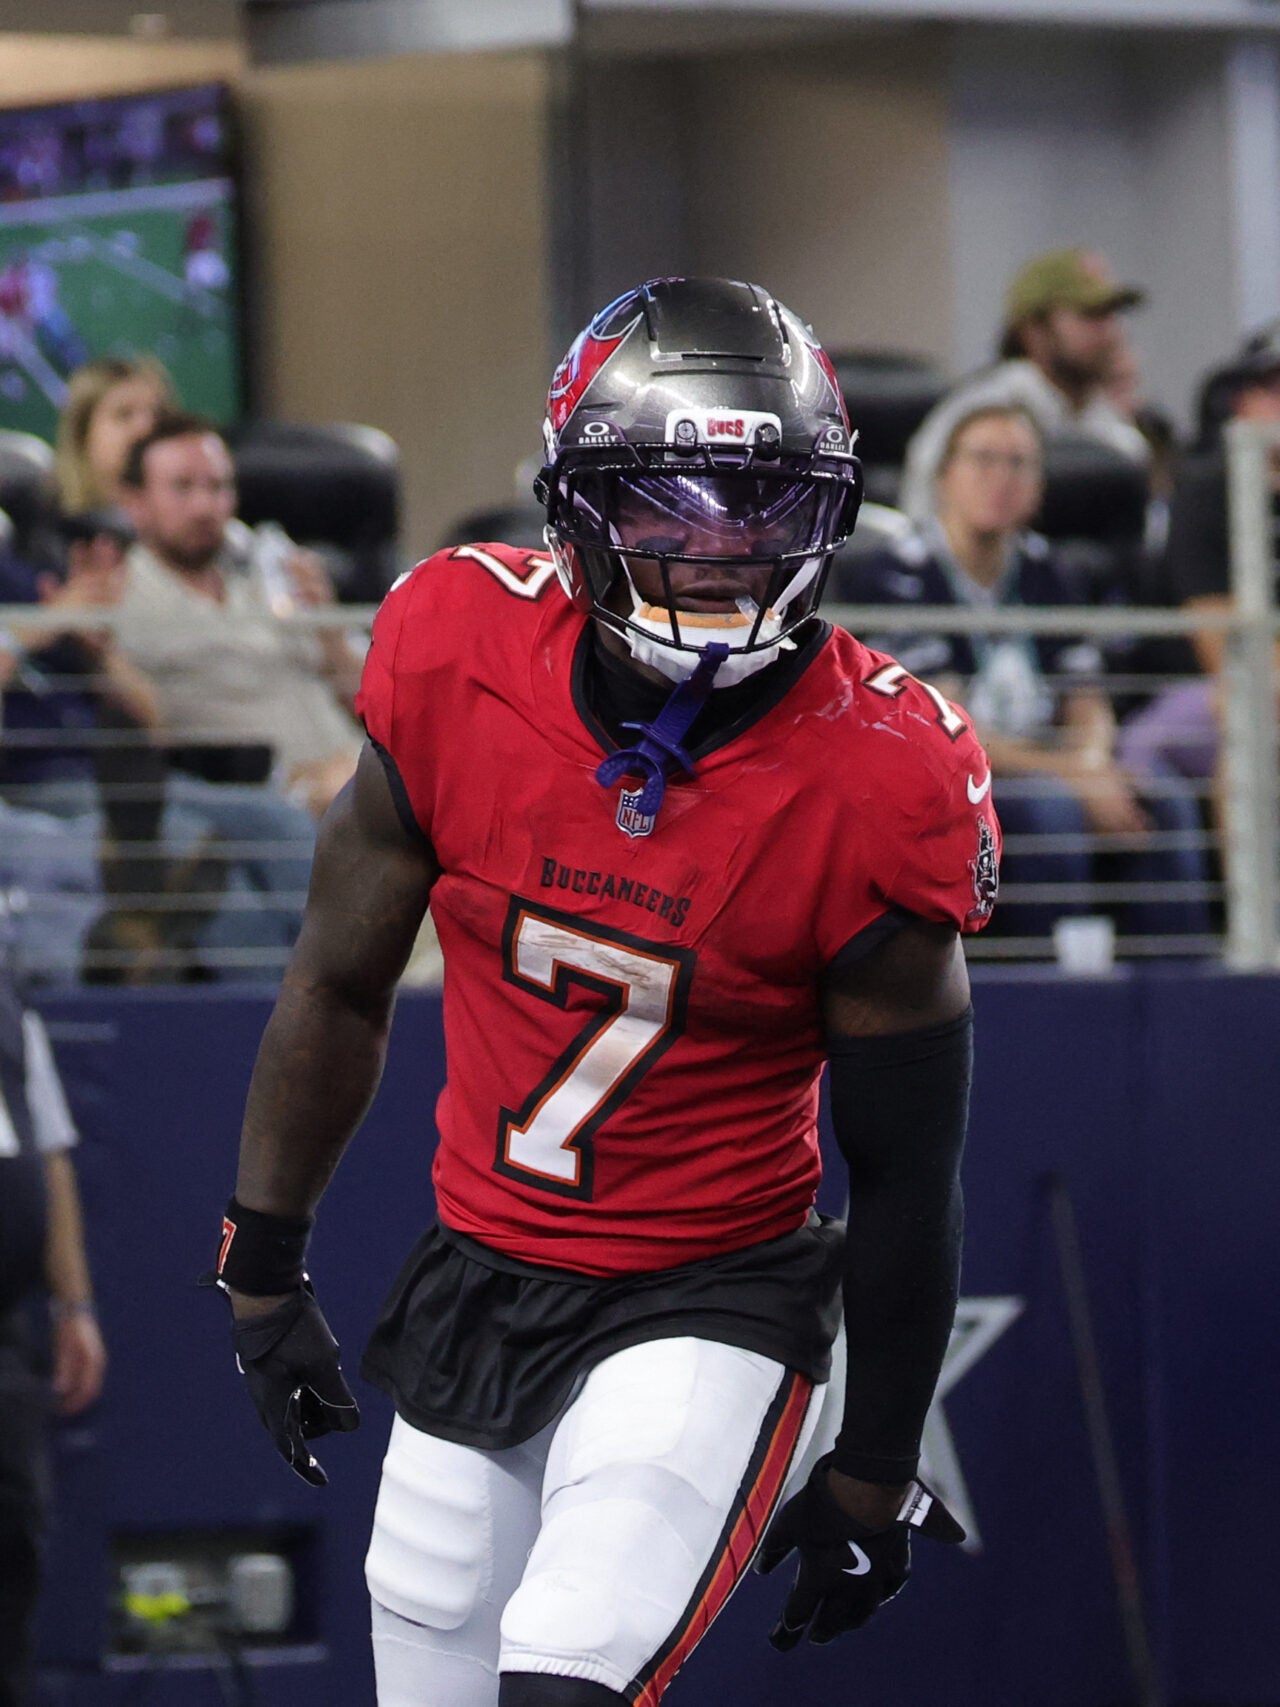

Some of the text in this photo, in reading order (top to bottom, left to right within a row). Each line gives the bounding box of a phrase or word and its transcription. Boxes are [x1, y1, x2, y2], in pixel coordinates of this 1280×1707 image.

[707, 418, 745, 437] BUCS
[578, 435, 618, 444] OAKLEY
[820, 442, 845, 451] OAKLEY
[861, 663, 969, 742] 7
[621, 808, 649, 830] NFL
[540, 857, 692, 928] BUCCANEERS
[493, 893, 697, 1202] 7
